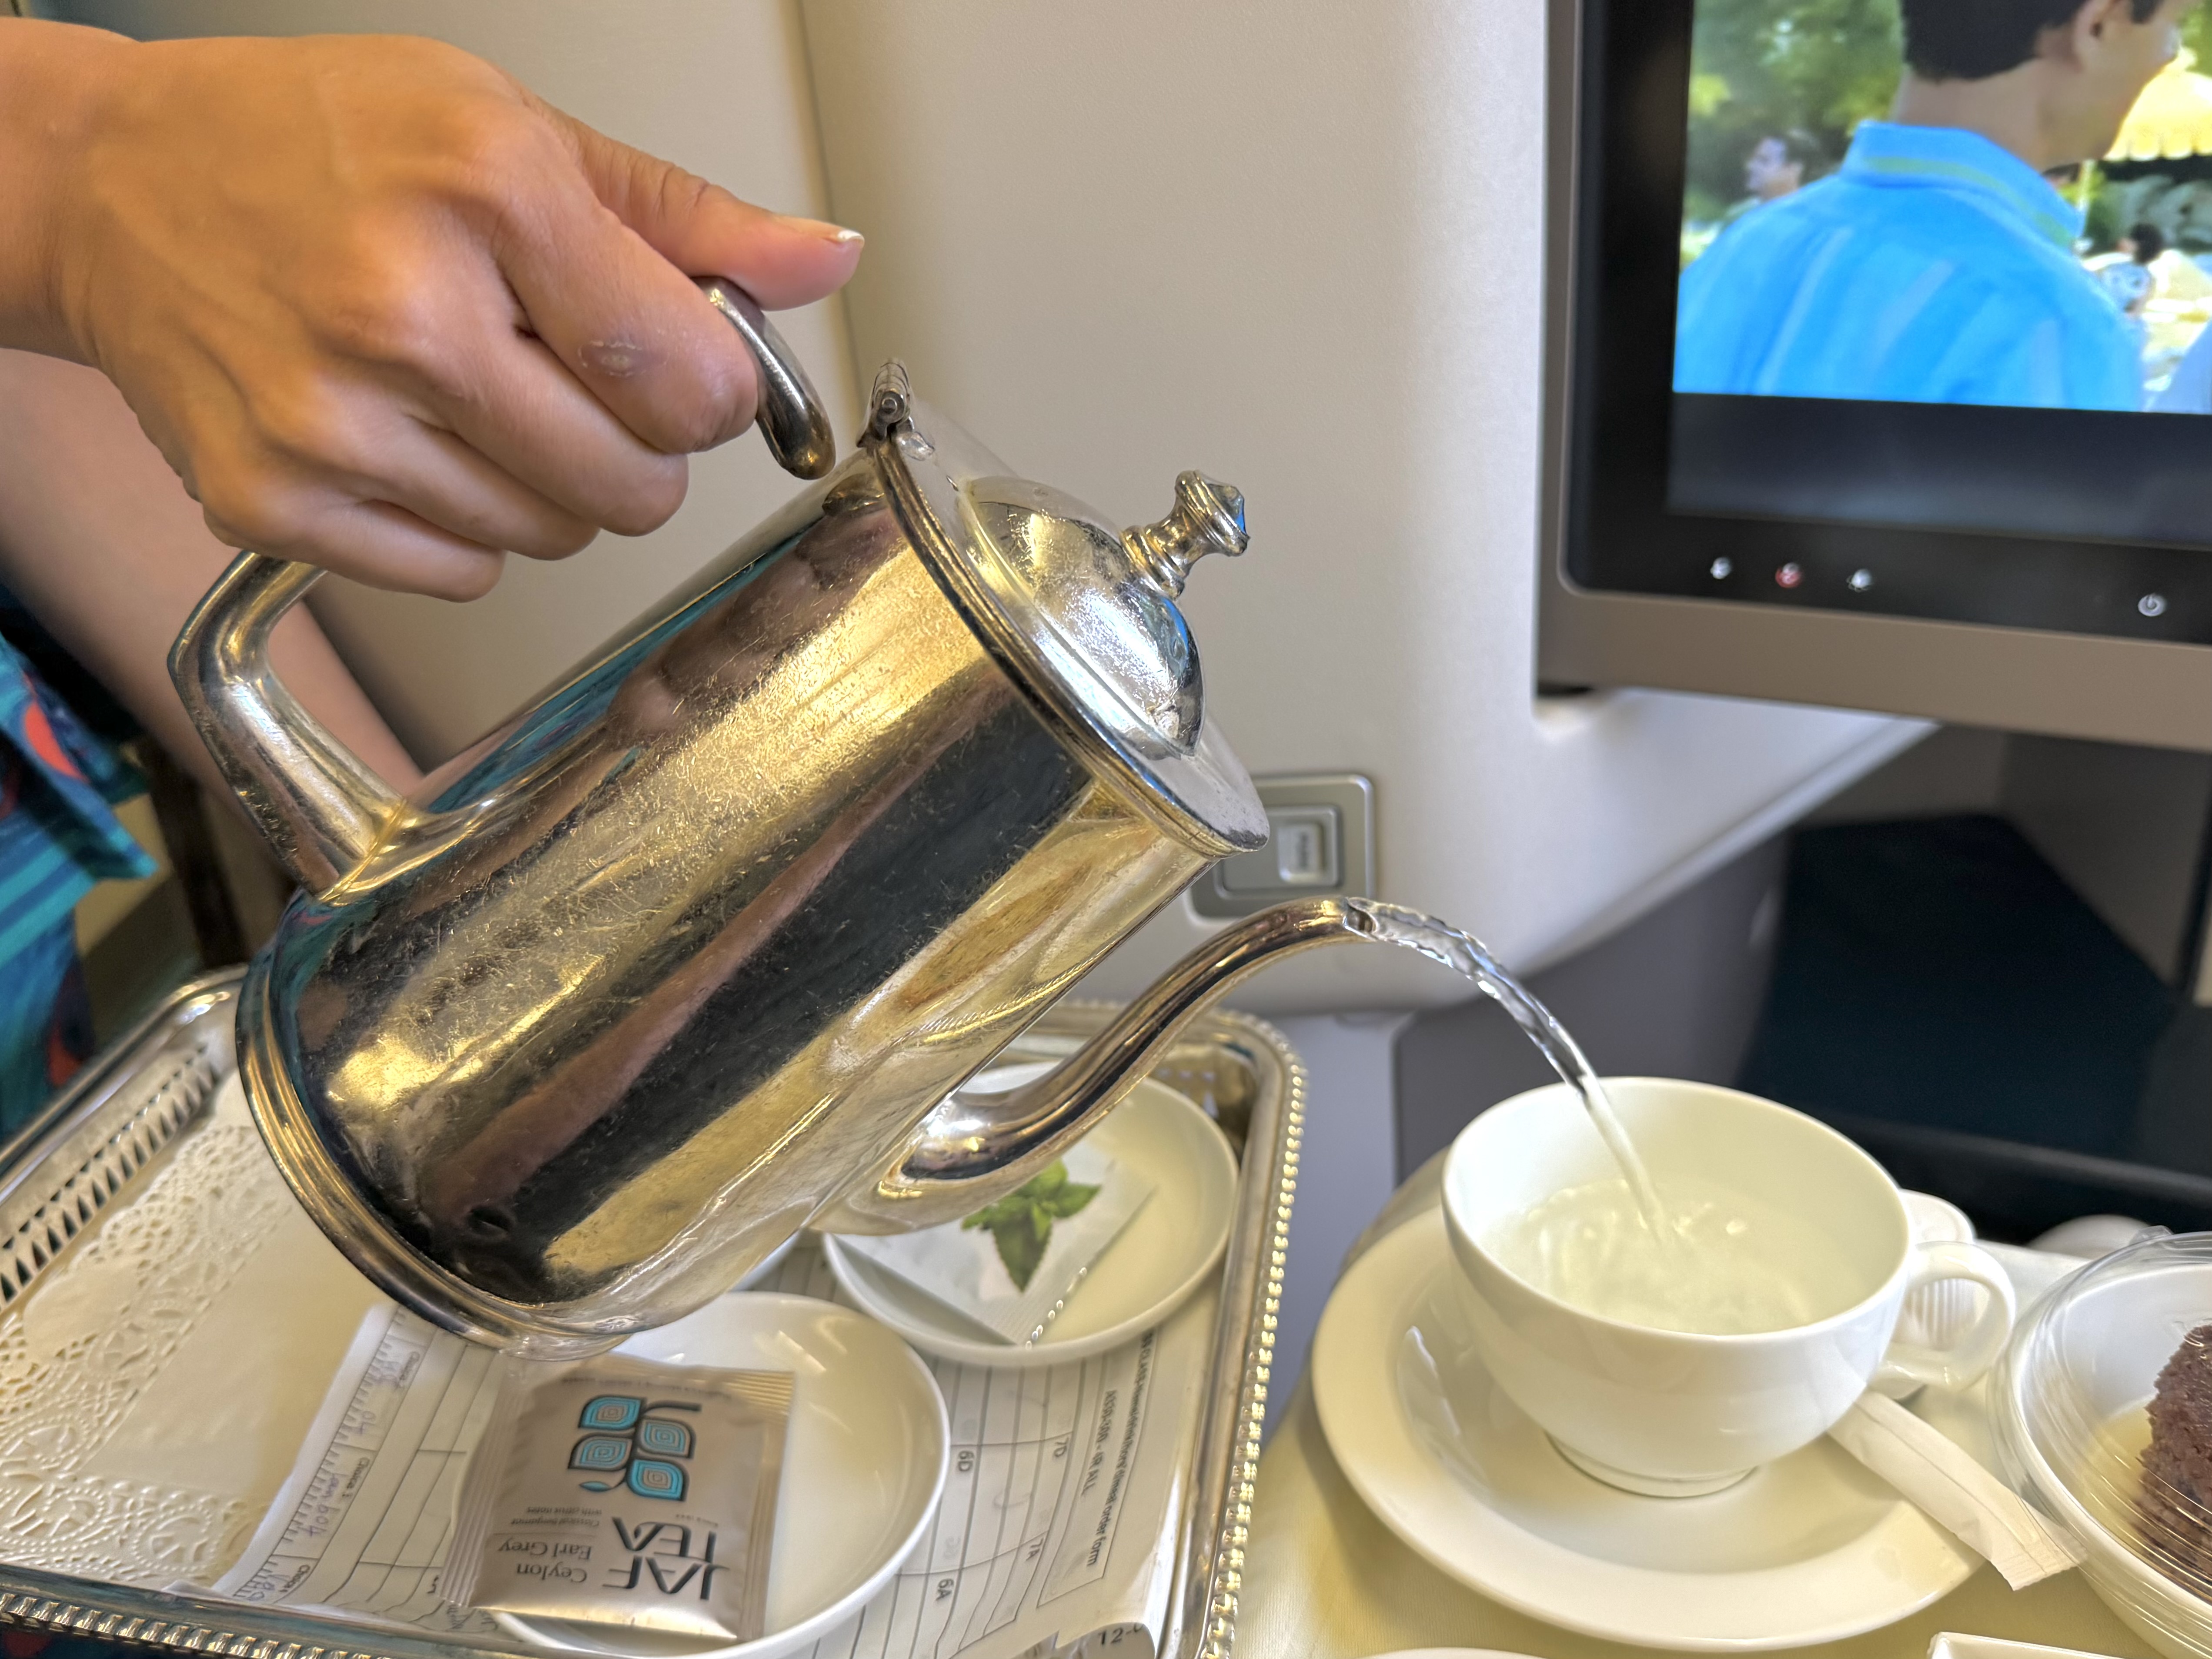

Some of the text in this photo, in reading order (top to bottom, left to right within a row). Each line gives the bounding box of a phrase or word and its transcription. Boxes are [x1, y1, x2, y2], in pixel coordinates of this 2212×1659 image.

[1053, 1436, 1069, 1458] 7D
[958, 1450, 975, 1472] 6D
[1095, 1505, 1112, 1535] order
[498, 1536, 592, 1560] Earl Grey
[611, 1516, 720, 1564] TEA
[1025, 1538, 1044, 1562] 7A
[1086, 1535, 1107, 1567] form
[516, 1561, 588, 1583] Ceylon
[601, 1555, 730, 1601] JAF
[935, 1578, 954, 1602] 6A
